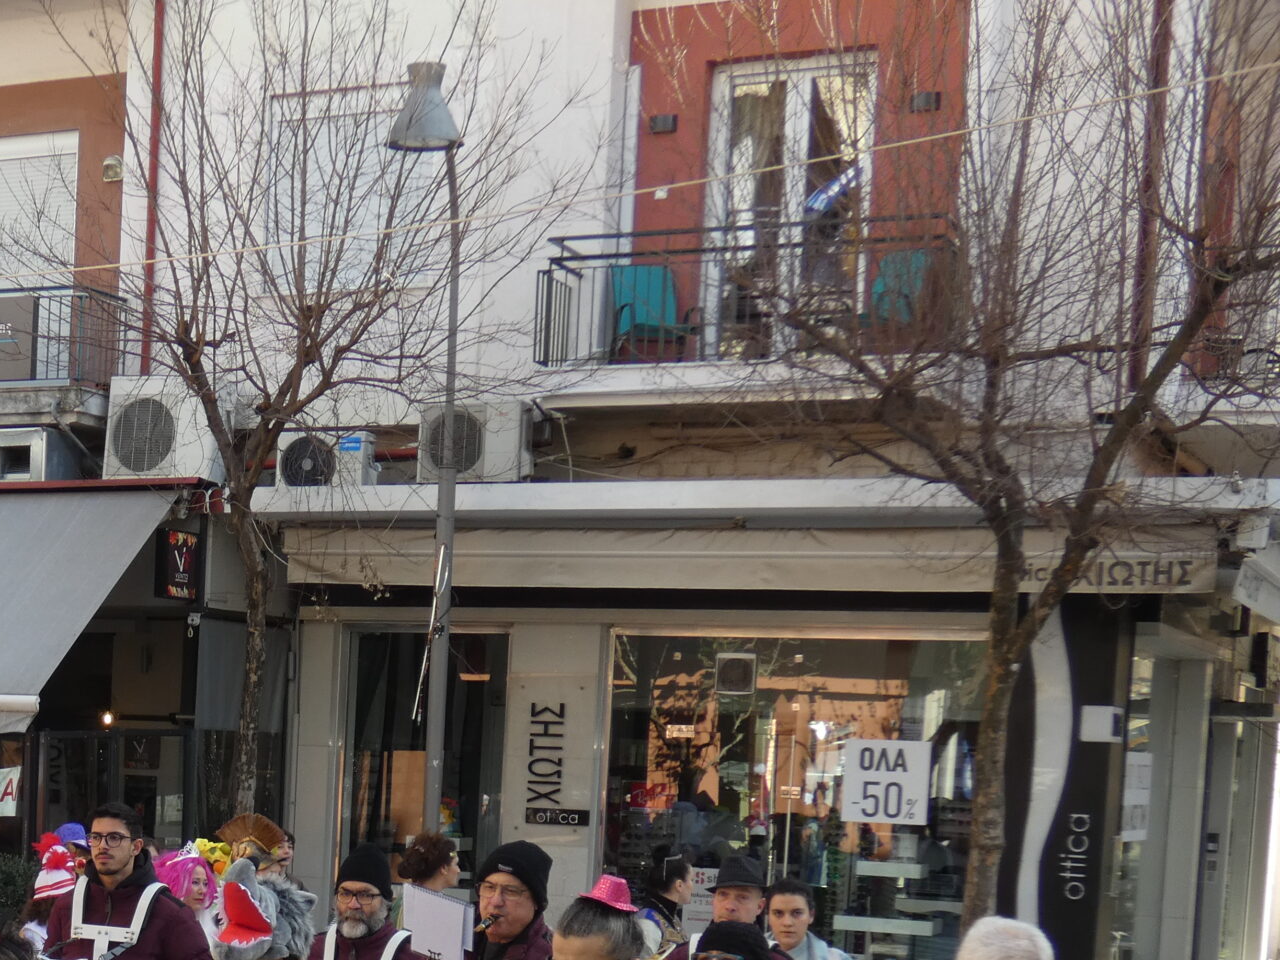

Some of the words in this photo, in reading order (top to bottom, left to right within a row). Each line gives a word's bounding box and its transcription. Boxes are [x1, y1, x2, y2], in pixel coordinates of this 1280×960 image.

[526, 703, 565, 804] ΧΙΩΤΗΣ
[860, 747, 908, 773] ΟΛΑ
[1058, 813, 1091, 900] ottica
